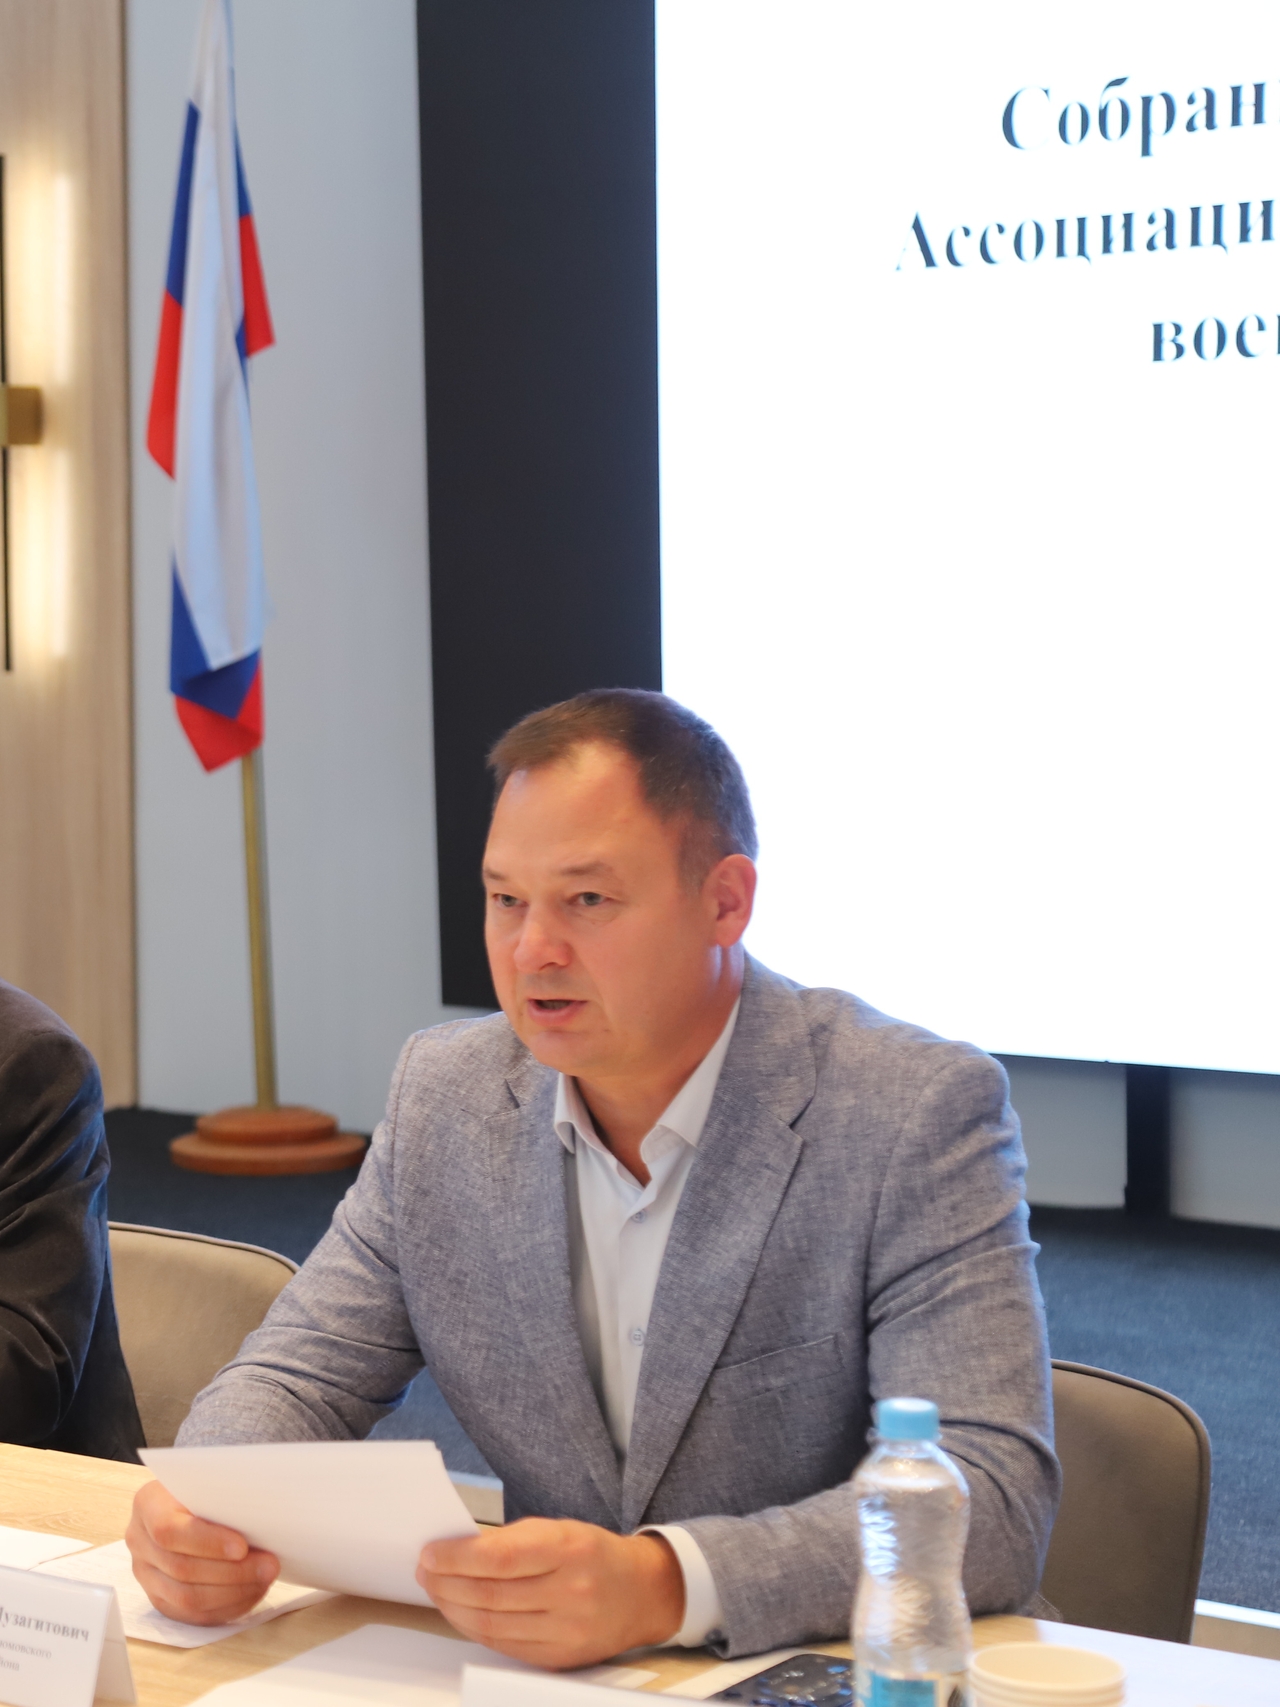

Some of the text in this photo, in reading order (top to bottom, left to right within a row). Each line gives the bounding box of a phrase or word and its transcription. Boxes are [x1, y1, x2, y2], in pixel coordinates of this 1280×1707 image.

[1001, 76, 1280, 158] Собран
[895, 199, 1275, 271] Ассоциаци
[1152, 313, 1280, 363] вое
